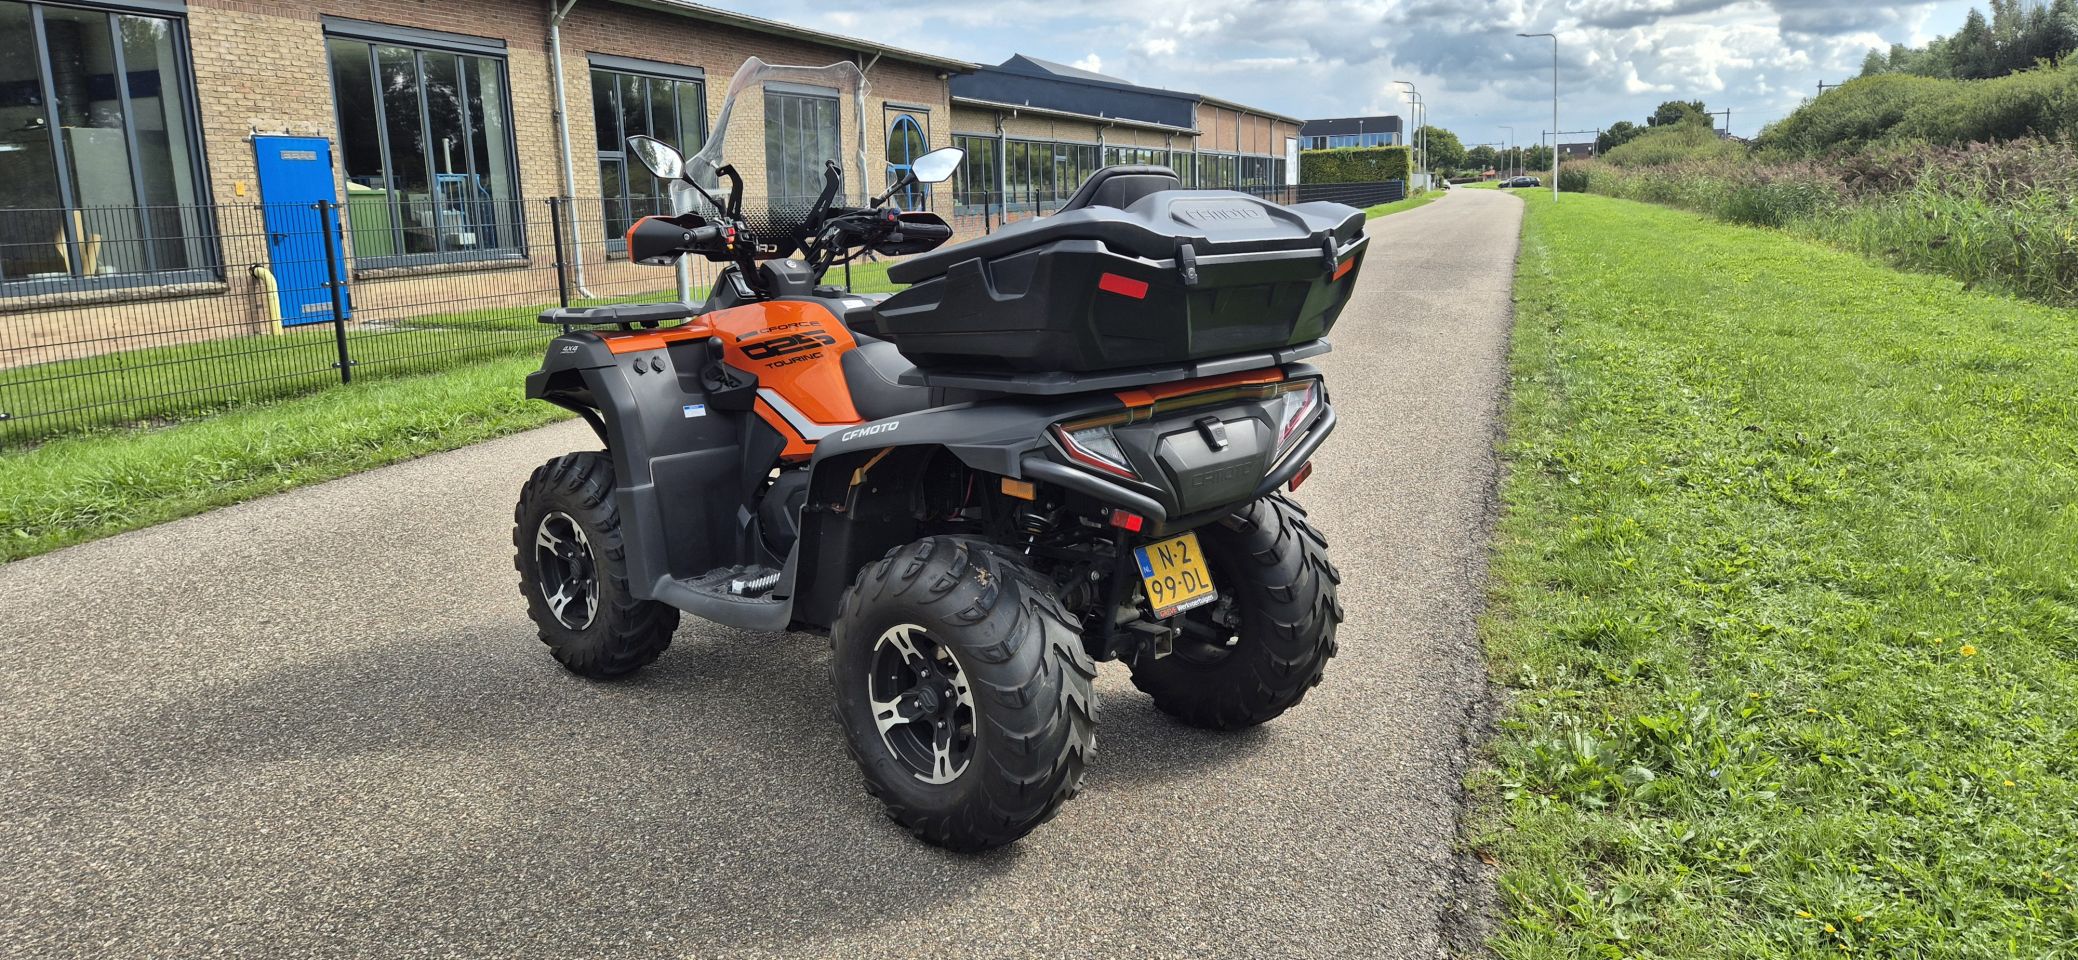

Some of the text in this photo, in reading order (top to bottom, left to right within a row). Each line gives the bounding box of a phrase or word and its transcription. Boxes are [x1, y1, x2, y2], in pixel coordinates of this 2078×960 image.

[759, 320, 823, 335] CFORCE
[765, 351, 824, 370] TOURING
[841, 420, 900, 442] CFMOTO
[1143, 565, 1152, 574] NL
